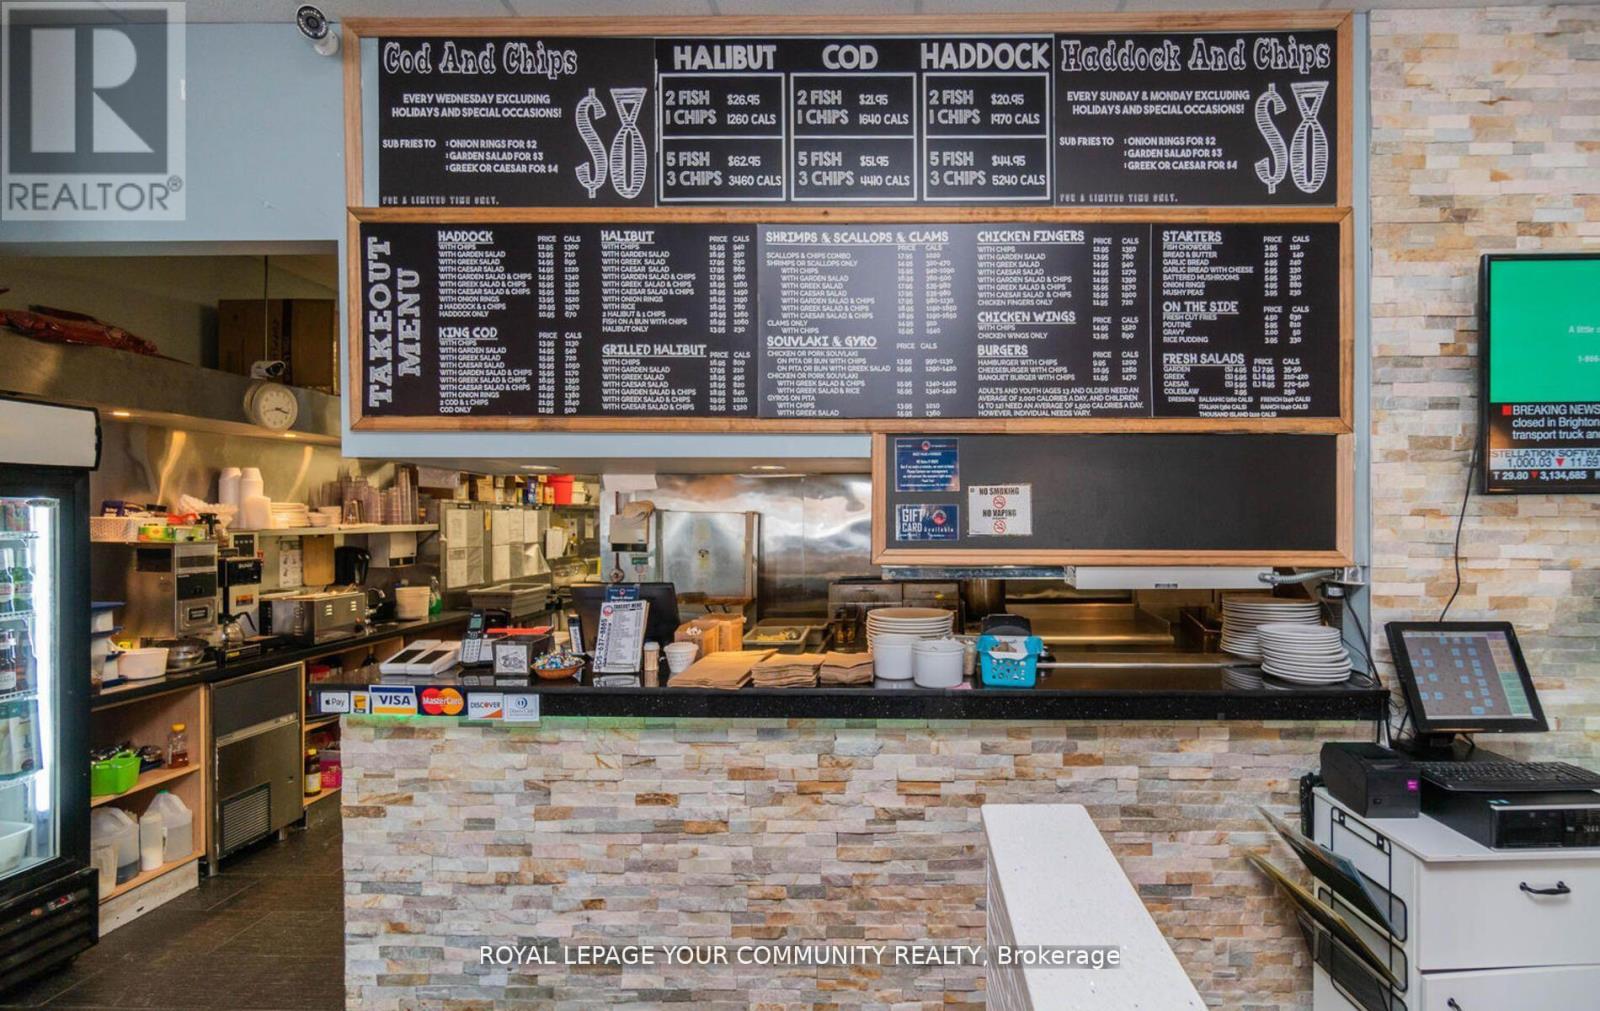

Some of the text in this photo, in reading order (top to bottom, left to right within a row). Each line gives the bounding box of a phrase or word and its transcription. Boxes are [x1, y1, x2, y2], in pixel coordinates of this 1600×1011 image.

[384, 41, 577, 79] Cod And Chips
[674, 45, 776, 69] HALIBUT
[822, 45, 878, 69] COD
[921, 43, 1049, 69] HADDOCK
[1061, 37, 1330, 74] Haddock And Chips
[403, 94, 550, 104] EVERY WEDNESDAY EXCLUDING
[666, 90, 760, 105] 2 FISH $26.95
[797, 90, 888, 105] 2 FISH $21.95
[929, 90, 1024, 105] 2 FISH $20.95
[1067, 91, 1250, 101] EVERY SUNDAY & MONDAY EXCLUDING
[392, 107, 561, 117] HOLIDAYS AND SPECIAL OCCASIONS!
[1073, 104, 1244, 114] HOLIDAYS AND SPECIAL OCCASIONS!
[666, 109, 776, 124] 1 CHIPS 1260 CALS
[798, 109, 909, 124] 1 CHIPS 1640 CALS
[929, 109, 1040, 124] 1 CHIPS 1970 CALS
[383, 139, 436, 148] SUB FRIES TO
[480, 140, 506, 148] RINGS
[507, 140, 525, 148] FOR
[527, 140, 537, 148] $2
[486, 152, 513, 160] SALAD
[514, 152, 531, 160] FOR
[533, 152, 543, 160] $3
[667, 151, 761, 166] 5 FISH $62.95
[798, 151, 889, 166] 5 FISH $51.95
[930, 151, 1025, 166] 5 FISH $44.95
[479, 164, 492, 172] OR
[493, 164, 527, 173] CAESAR
[529, 164, 546, 173] FOR
[548, 164, 558, 173] $4
[667, 171, 781, 186] 3 CHIPS 3460 CALS
[799, 171, 910, 186] 3 CHIPS 4410 CALS
[930, 171, 1045, 185] 3 CHIPS 5240 CALS
[438, 231, 492, 242] HADDOCK
[601, 231, 654, 242] HALIBUT
[766, 232, 817, 242] SHRIMPS
[833, 232, 892, 243] SCALLOPS
[909, 231, 948, 242] CLAMS
[977, 231, 1084, 242] CHICKEN FINGERS
[1163, 231, 1221, 242] STARTERS
[1163, 301, 1238, 312] ON THE SIDE
[368, 237, 392, 407] TAKEOUT
[397, 268, 420, 376] MENU
[977, 311, 1075, 323] CHICKEN WINGS
[439, 327, 497, 339] KING COD
[767, 336, 828, 346] SOUVLAKI
[845, 336, 877, 347] GYRO
[602, 344, 707, 355] GRILLED HALIBUT
[978, 345, 1028, 356] BURGERS
[1163, 353, 1244, 364] FRESH SALADS
[1512, 404, 1600, 416] BREAKING NEWS
[1512, 417, 1545, 428] closed
[1547, 417, 1556, 428] in
[1512, 430, 1585, 442] transport truck
[902, 508, 923, 522] GIFT
[902, 522, 923, 533] CARD
[331, 698, 345, 707] Pay
[380, 695, 411, 706] VISA
